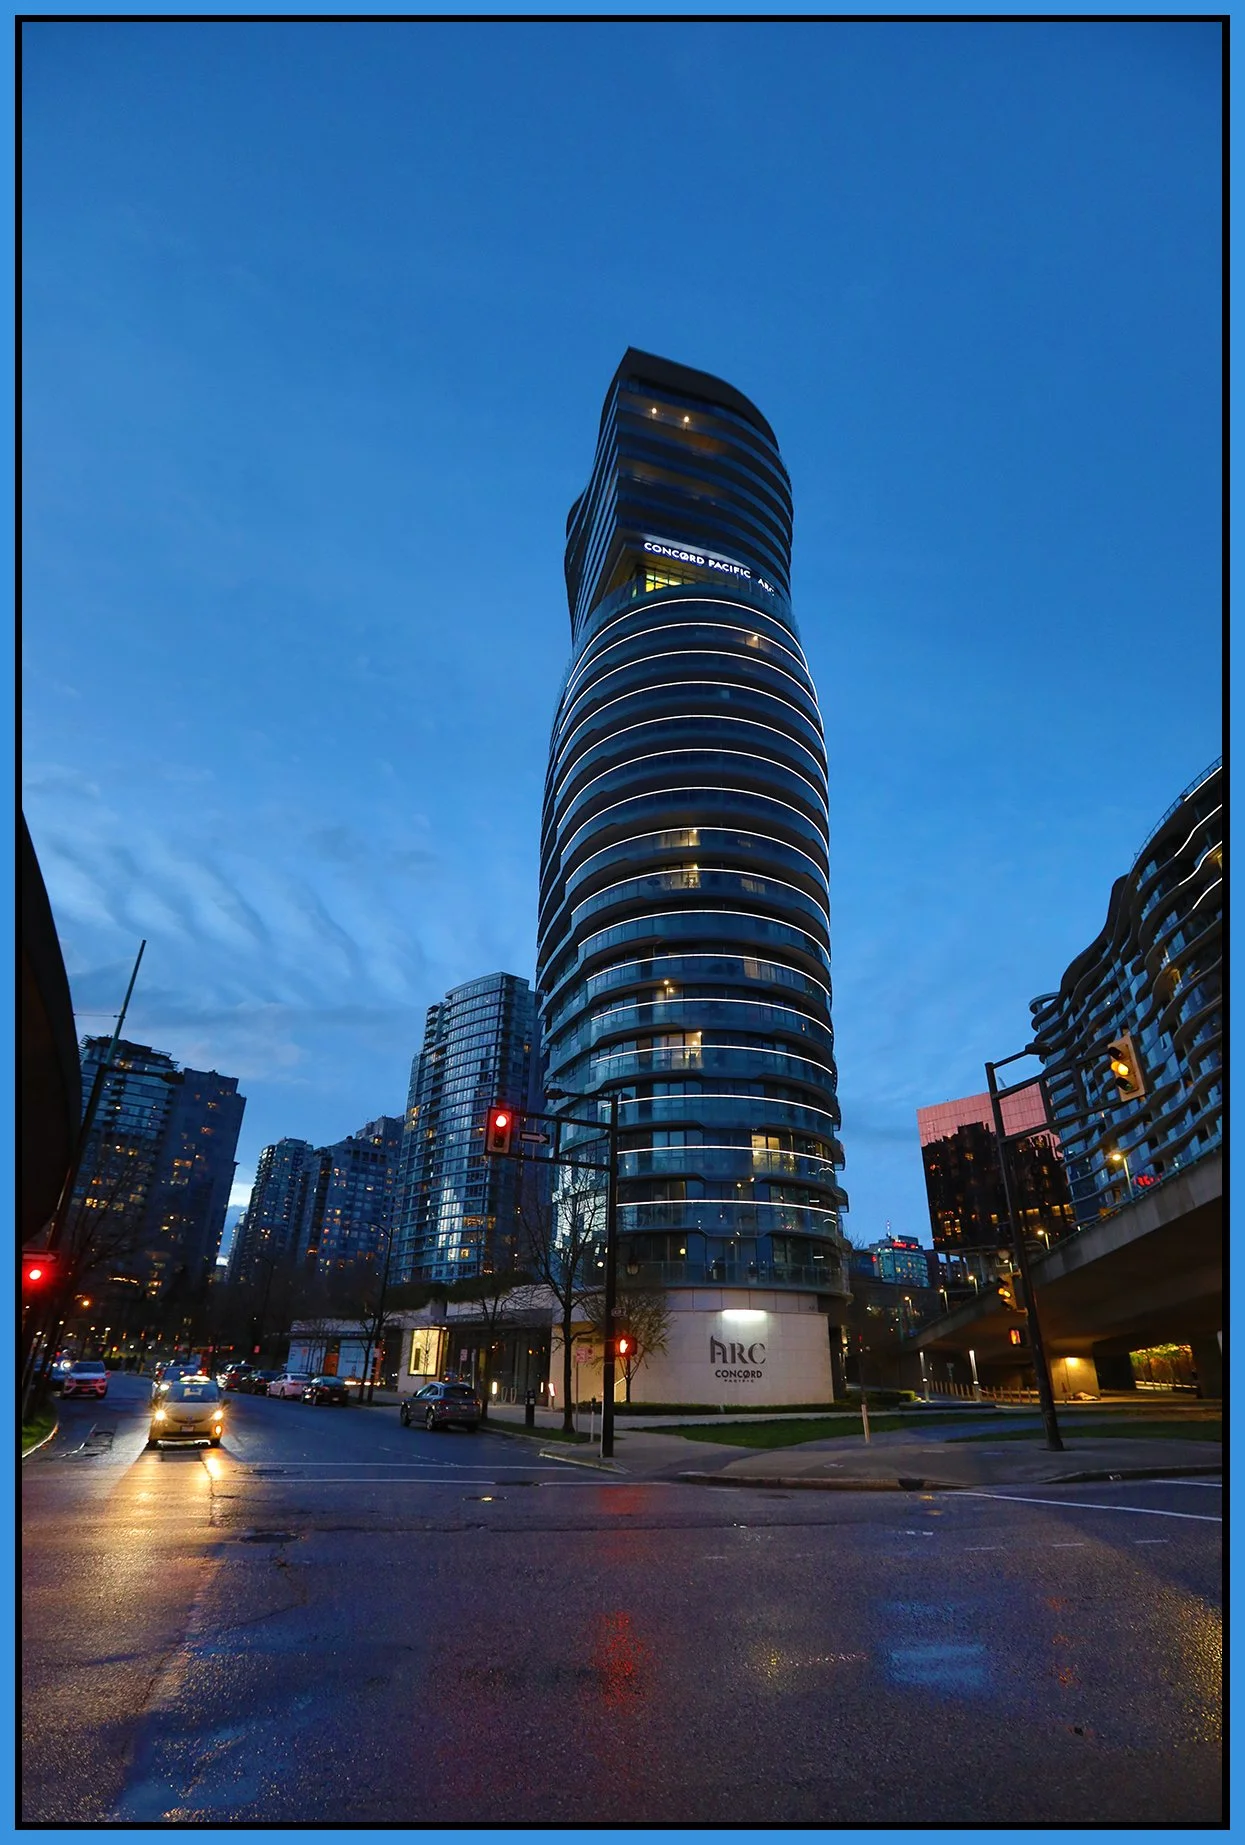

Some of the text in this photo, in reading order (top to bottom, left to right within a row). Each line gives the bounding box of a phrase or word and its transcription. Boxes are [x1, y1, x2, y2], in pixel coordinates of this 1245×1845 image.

[643, 542, 705, 565] CONCORD
[708, 559, 751, 579] PACIFIC
[710, 1335, 767, 1364] ARC
[715, 1369, 763, 1379] CONCORD
